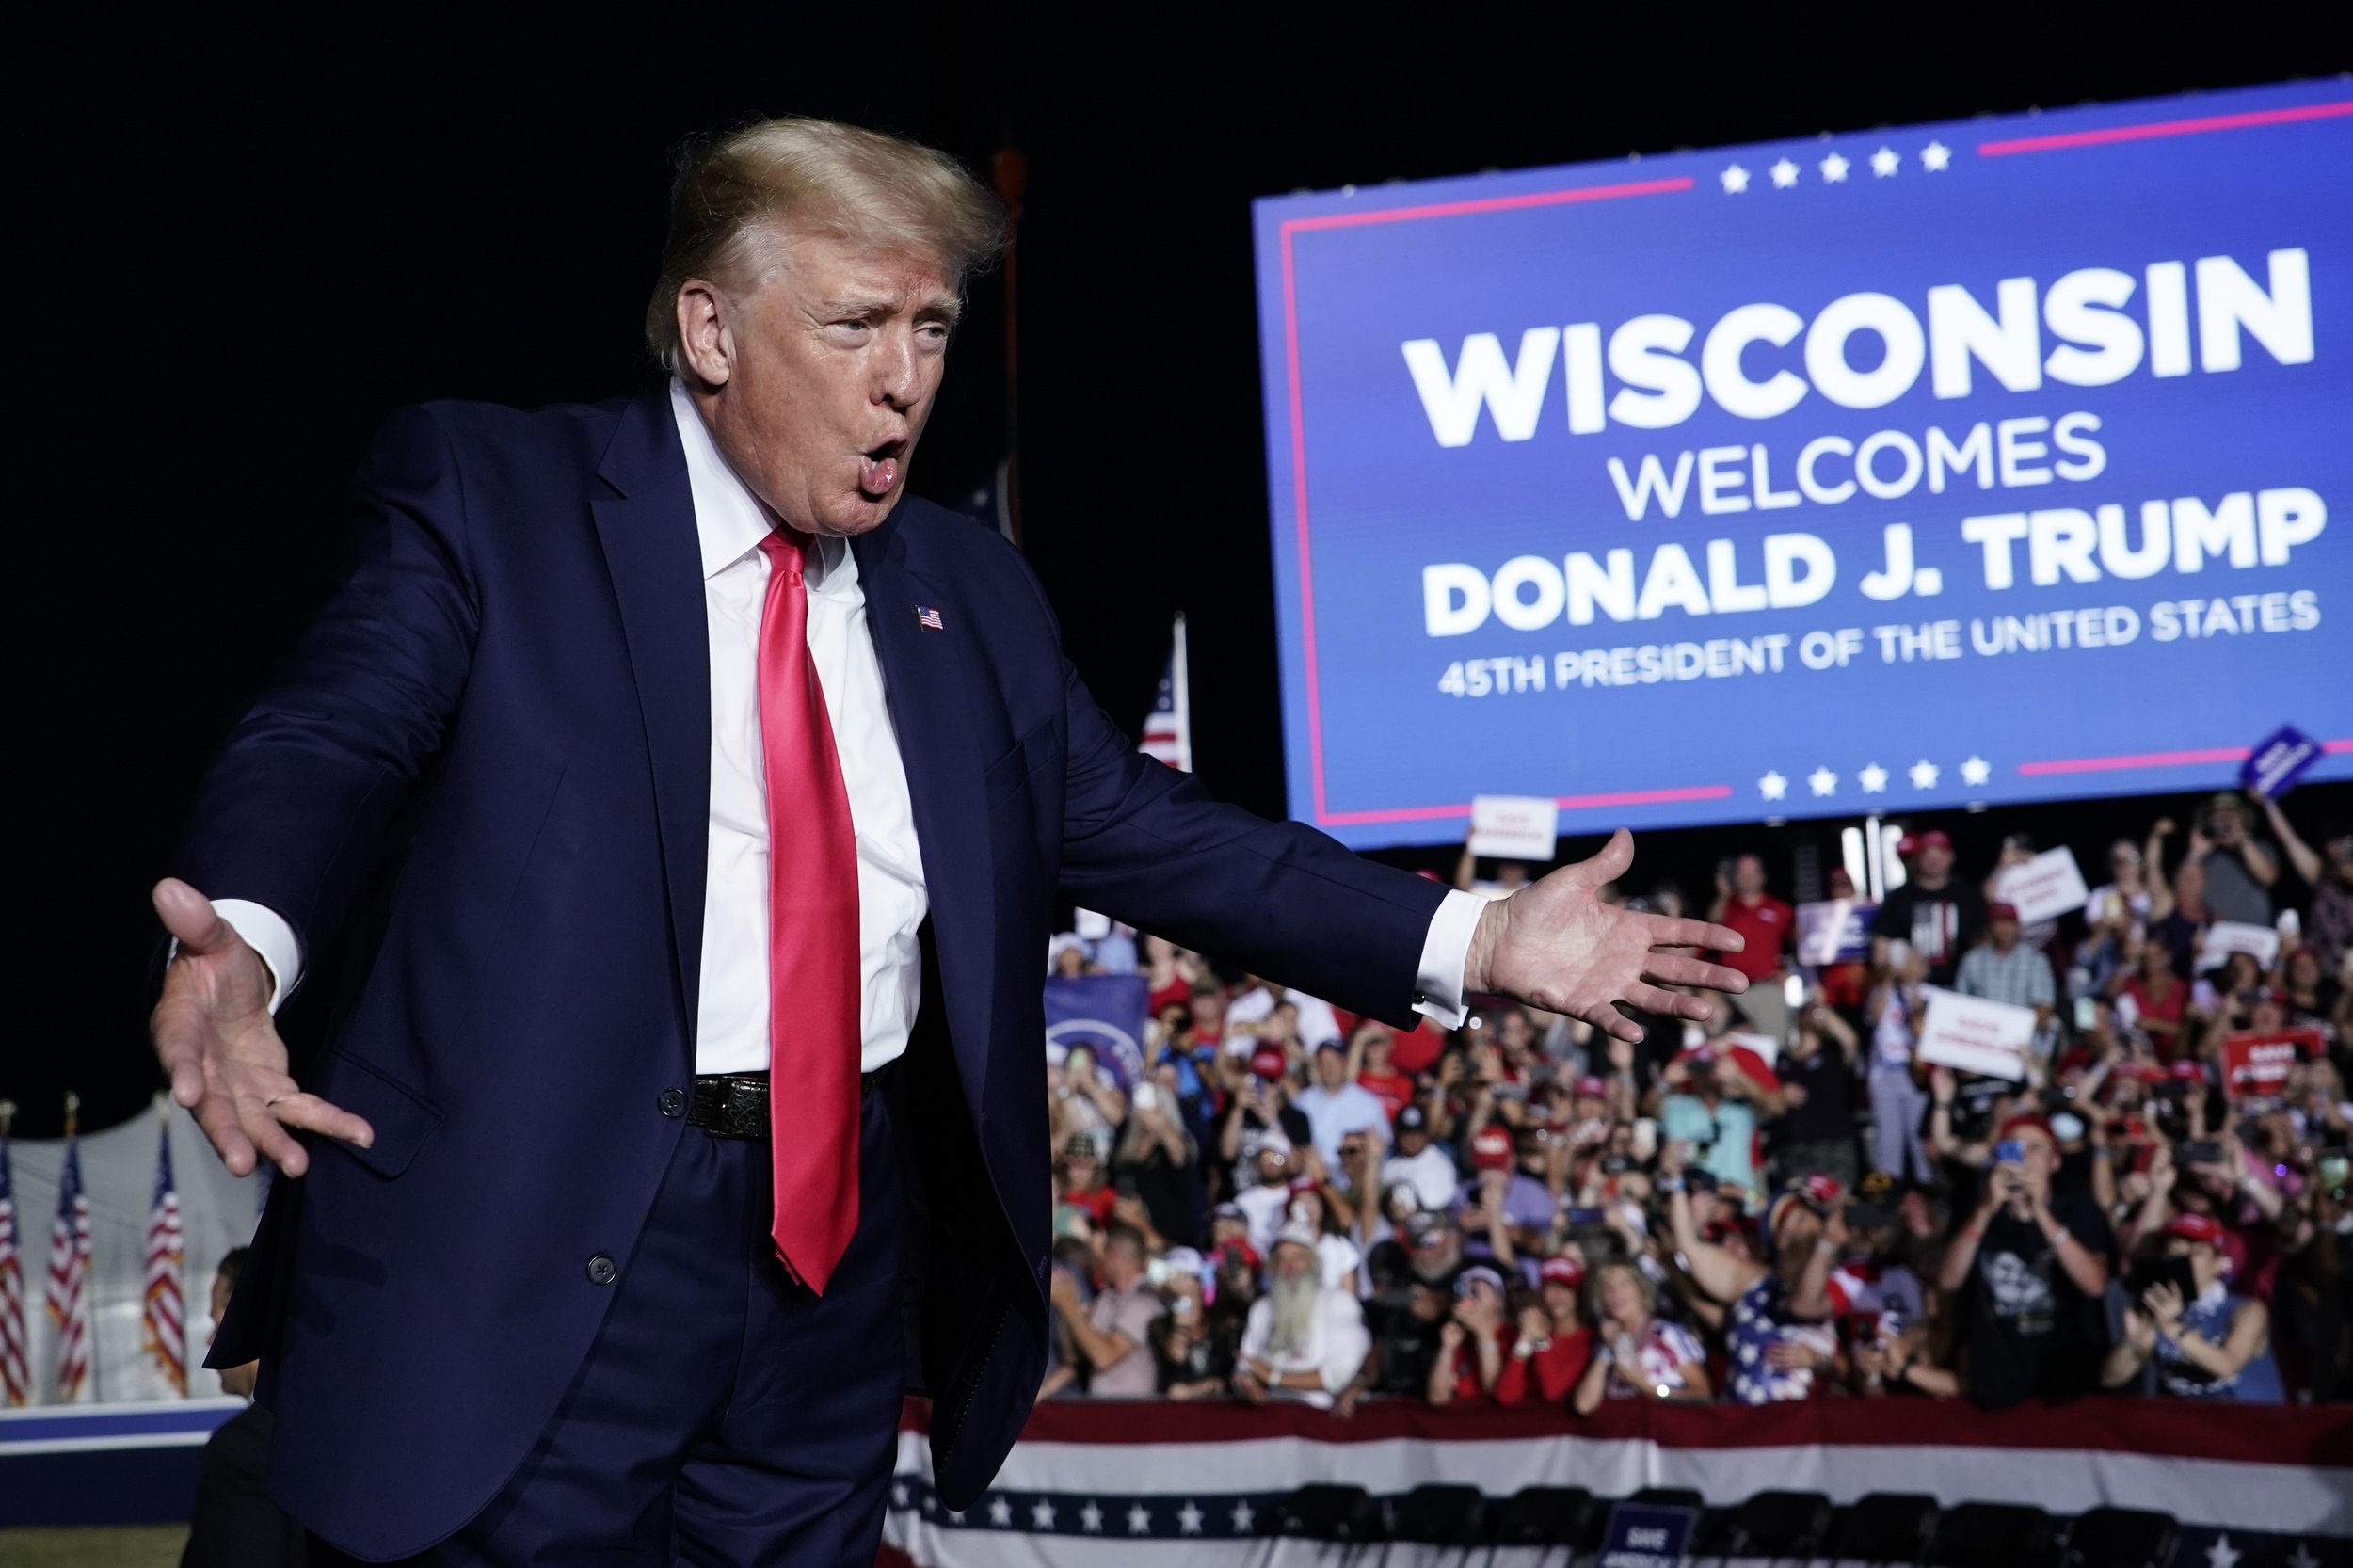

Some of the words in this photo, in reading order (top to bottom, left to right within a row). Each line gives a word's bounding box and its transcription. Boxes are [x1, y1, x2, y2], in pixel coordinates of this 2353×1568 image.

[1400, 247, 2315, 449] WISCONSIN
[1606, 410, 2107, 522] WELCOMES
[1420, 531, 1838, 638] DONALD
[1858, 522, 1945, 602] J.
[1960, 486, 2329, 592] TRUMP
[1436, 649, 1546, 698] 45TH
[1553, 633, 1792, 691] PRESIDENT
[1798, 627, 1865, 671] OF
[1871, 619, 1963, 664] THE
[1970, 604, 2142, 658] UNITED
[2148, 589, 2322, 643] STATES
